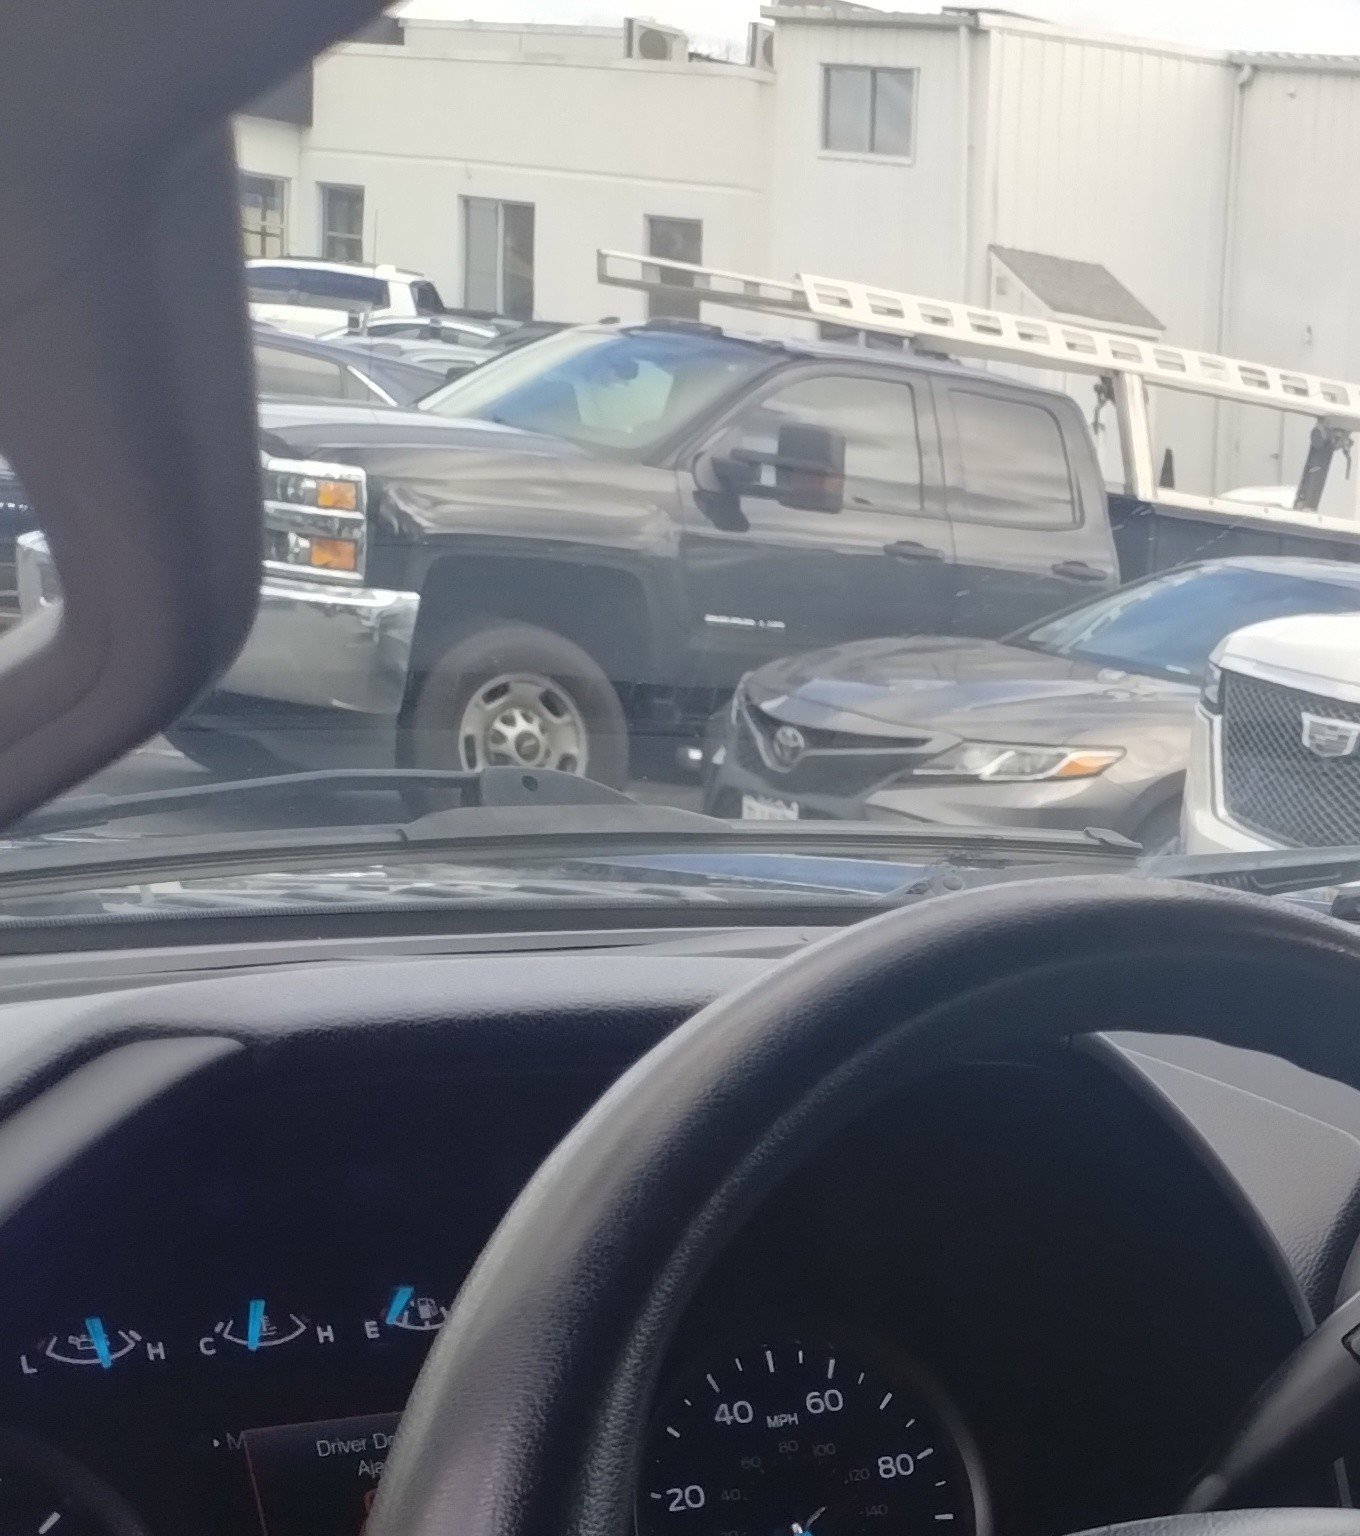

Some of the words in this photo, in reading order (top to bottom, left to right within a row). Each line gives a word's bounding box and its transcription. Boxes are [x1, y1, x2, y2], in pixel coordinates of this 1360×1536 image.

[317, 1324, 335, 1344] H
[364, 1320, 381, 1340] E
[147, 1341, 166, 1361] H
[199, 1337, 217, 1356] C
[19, 1355, 38, 1374] L
[805, 1388, 845, 1415] 60
[714, 1399, 754, 1426] 40
[766, 1411, 800, 1430] MPH
[315, 1434, 368, 1457] Driver
[877, 1452, 915, 1479] 80
[665, 1484, 706, 1512] 20
